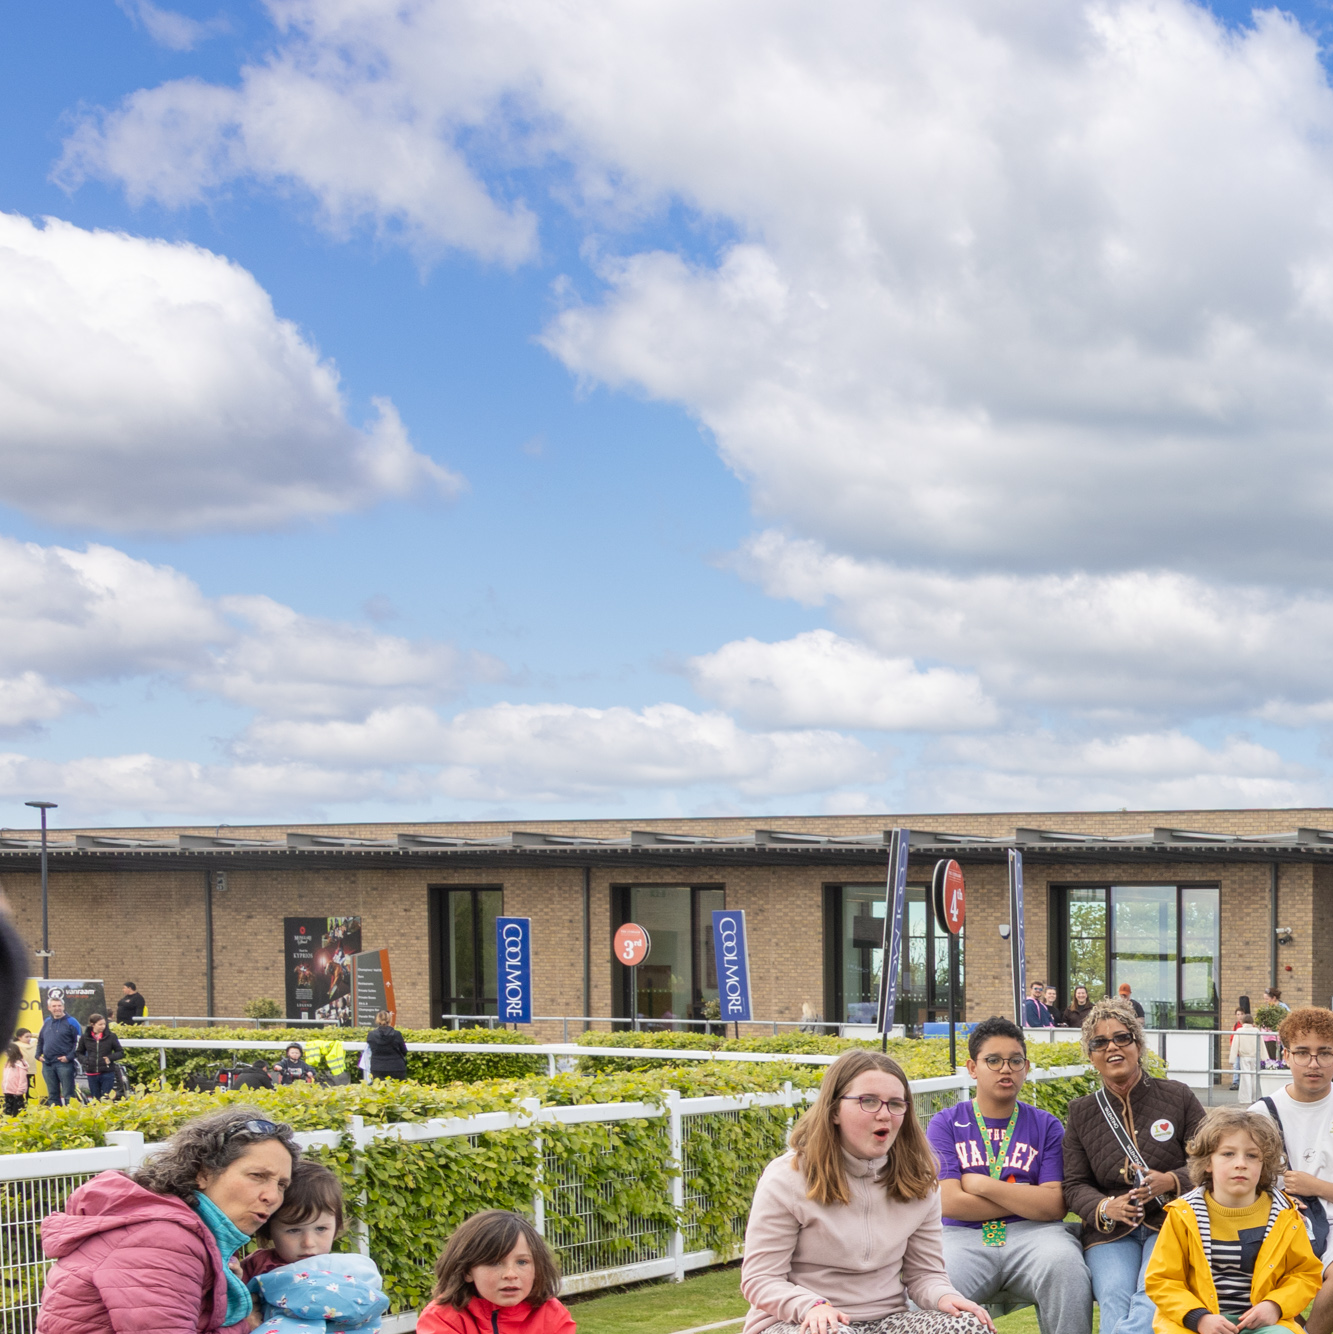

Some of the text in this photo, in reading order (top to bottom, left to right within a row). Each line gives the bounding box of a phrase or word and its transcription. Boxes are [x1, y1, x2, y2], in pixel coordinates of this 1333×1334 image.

[950, 888, 963, 922] 4th
[623, 939, 642, 959] 3rd
[720, 917, 742, 1015] COOLMORE
[503, 923, 522, 1018] COOLMORE
[987, 1128, 1007, 1141] THE
